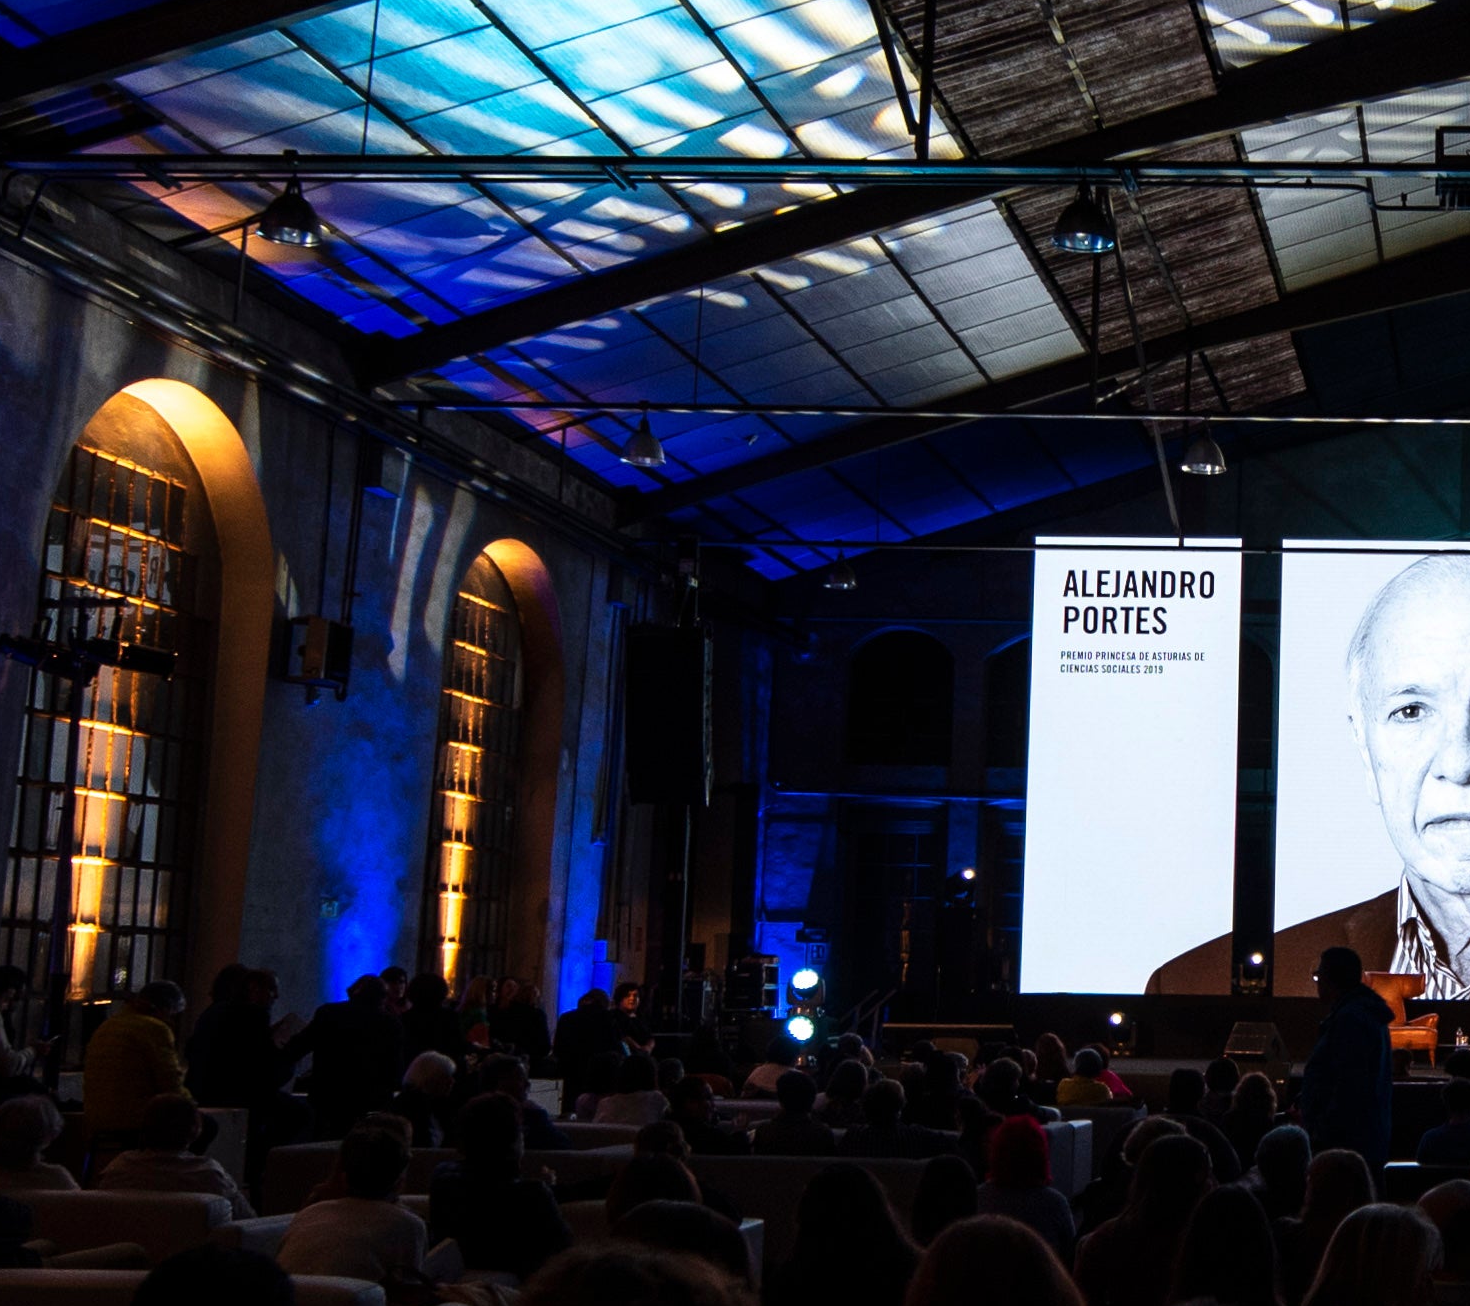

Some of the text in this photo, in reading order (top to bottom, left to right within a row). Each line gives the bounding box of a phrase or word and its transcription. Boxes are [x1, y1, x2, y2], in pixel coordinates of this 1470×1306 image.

[1063, 570, 1214, 599] ALEJANDRO
[1063, 606, 1167, 635] PORTES
[1060, 650, 1205, 662] PREMIO PRINCESA DE ASTURIAS DE
[1059, 663, 1164, 675] CIENCIAS SOCIALES 2019
